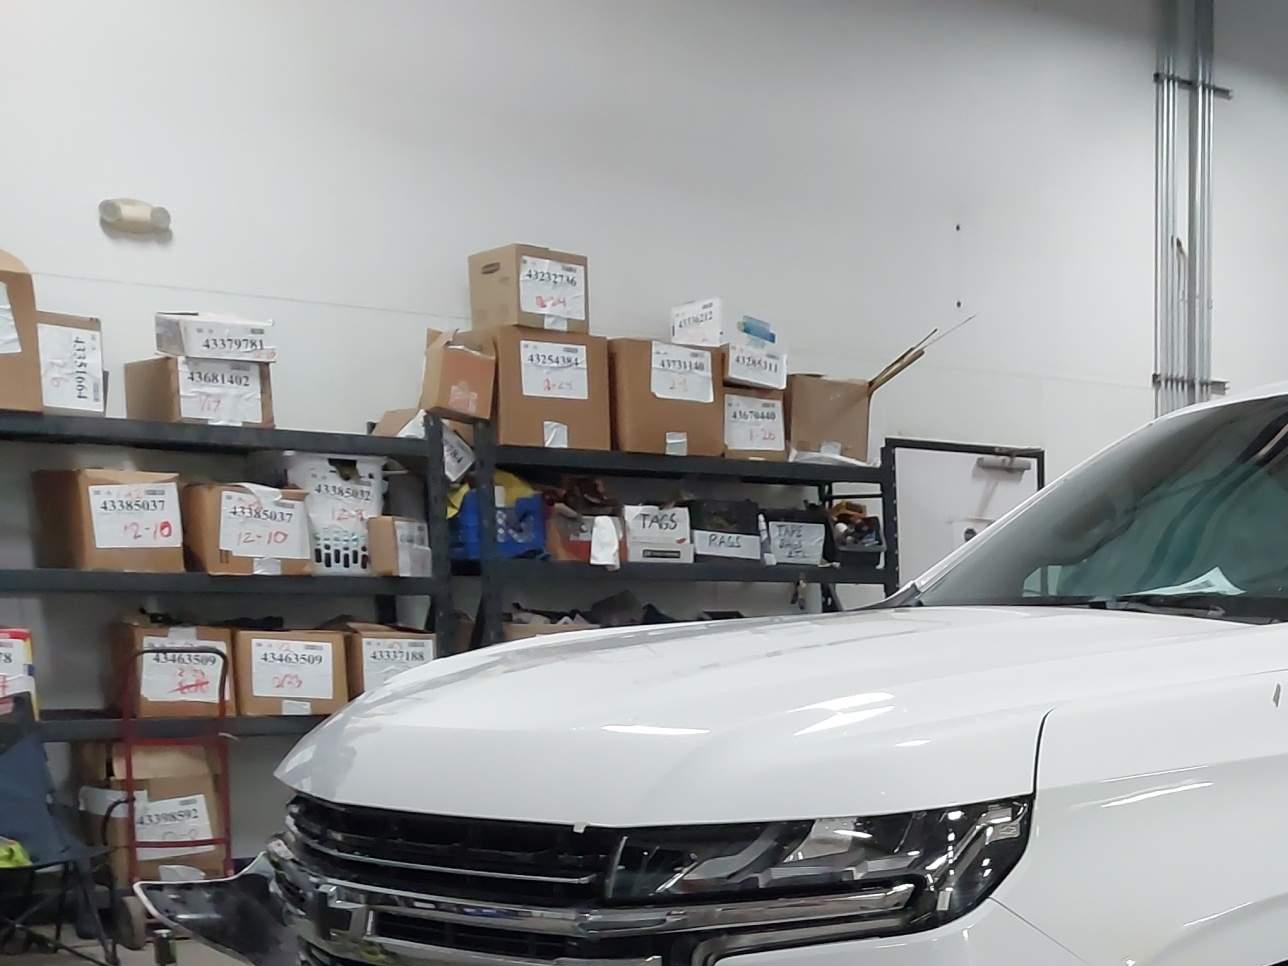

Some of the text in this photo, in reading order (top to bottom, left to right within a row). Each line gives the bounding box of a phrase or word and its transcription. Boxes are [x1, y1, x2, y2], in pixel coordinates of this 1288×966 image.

[202, 338, 264, 351] 43379781
[187, 371, 250, 388] 43681402
[100, 499, 166, 513] 43385037
[229, 505, 293, 523] 43385037
[639, 512, 679, 531] TAGS
[260, 651, 323, 665] 43463509
[369, 649, 425, 662] 43337188
